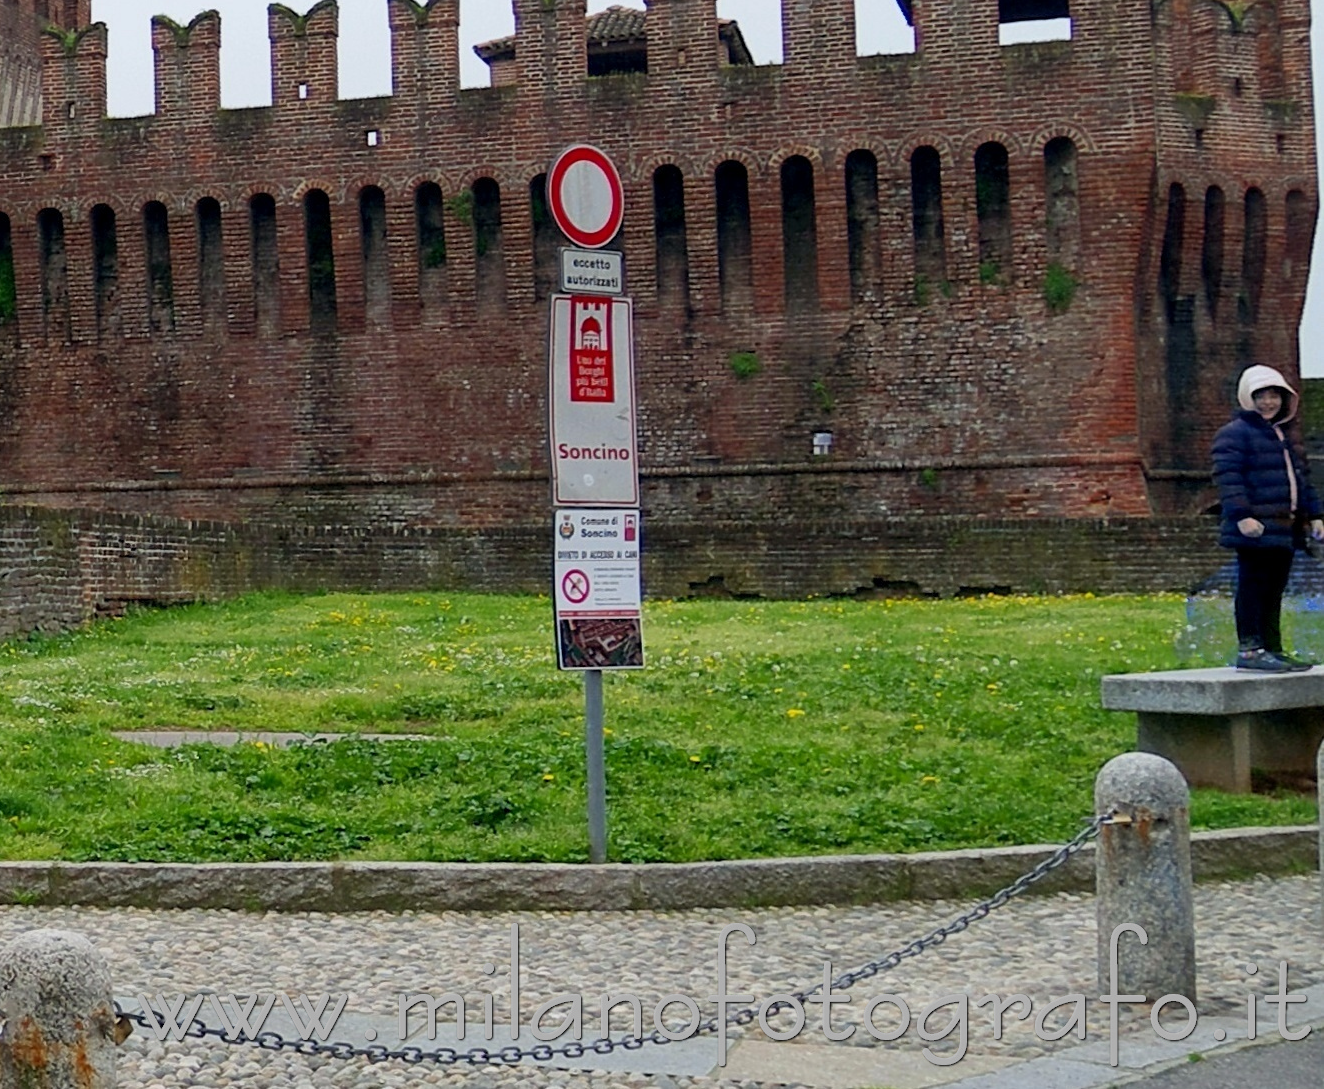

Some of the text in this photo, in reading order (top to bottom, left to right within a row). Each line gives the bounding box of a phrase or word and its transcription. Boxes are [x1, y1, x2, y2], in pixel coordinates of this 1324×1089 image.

[573, 258, 611, 270] eccetto
[567, 275, 619, 287] autorizzati
[579, 367, 605, 377] Borghi
[558, 443, 630, 461] Soncino
[581, 516, 618, 525] Comune di
[581, 528, 618, 537] Soncino
